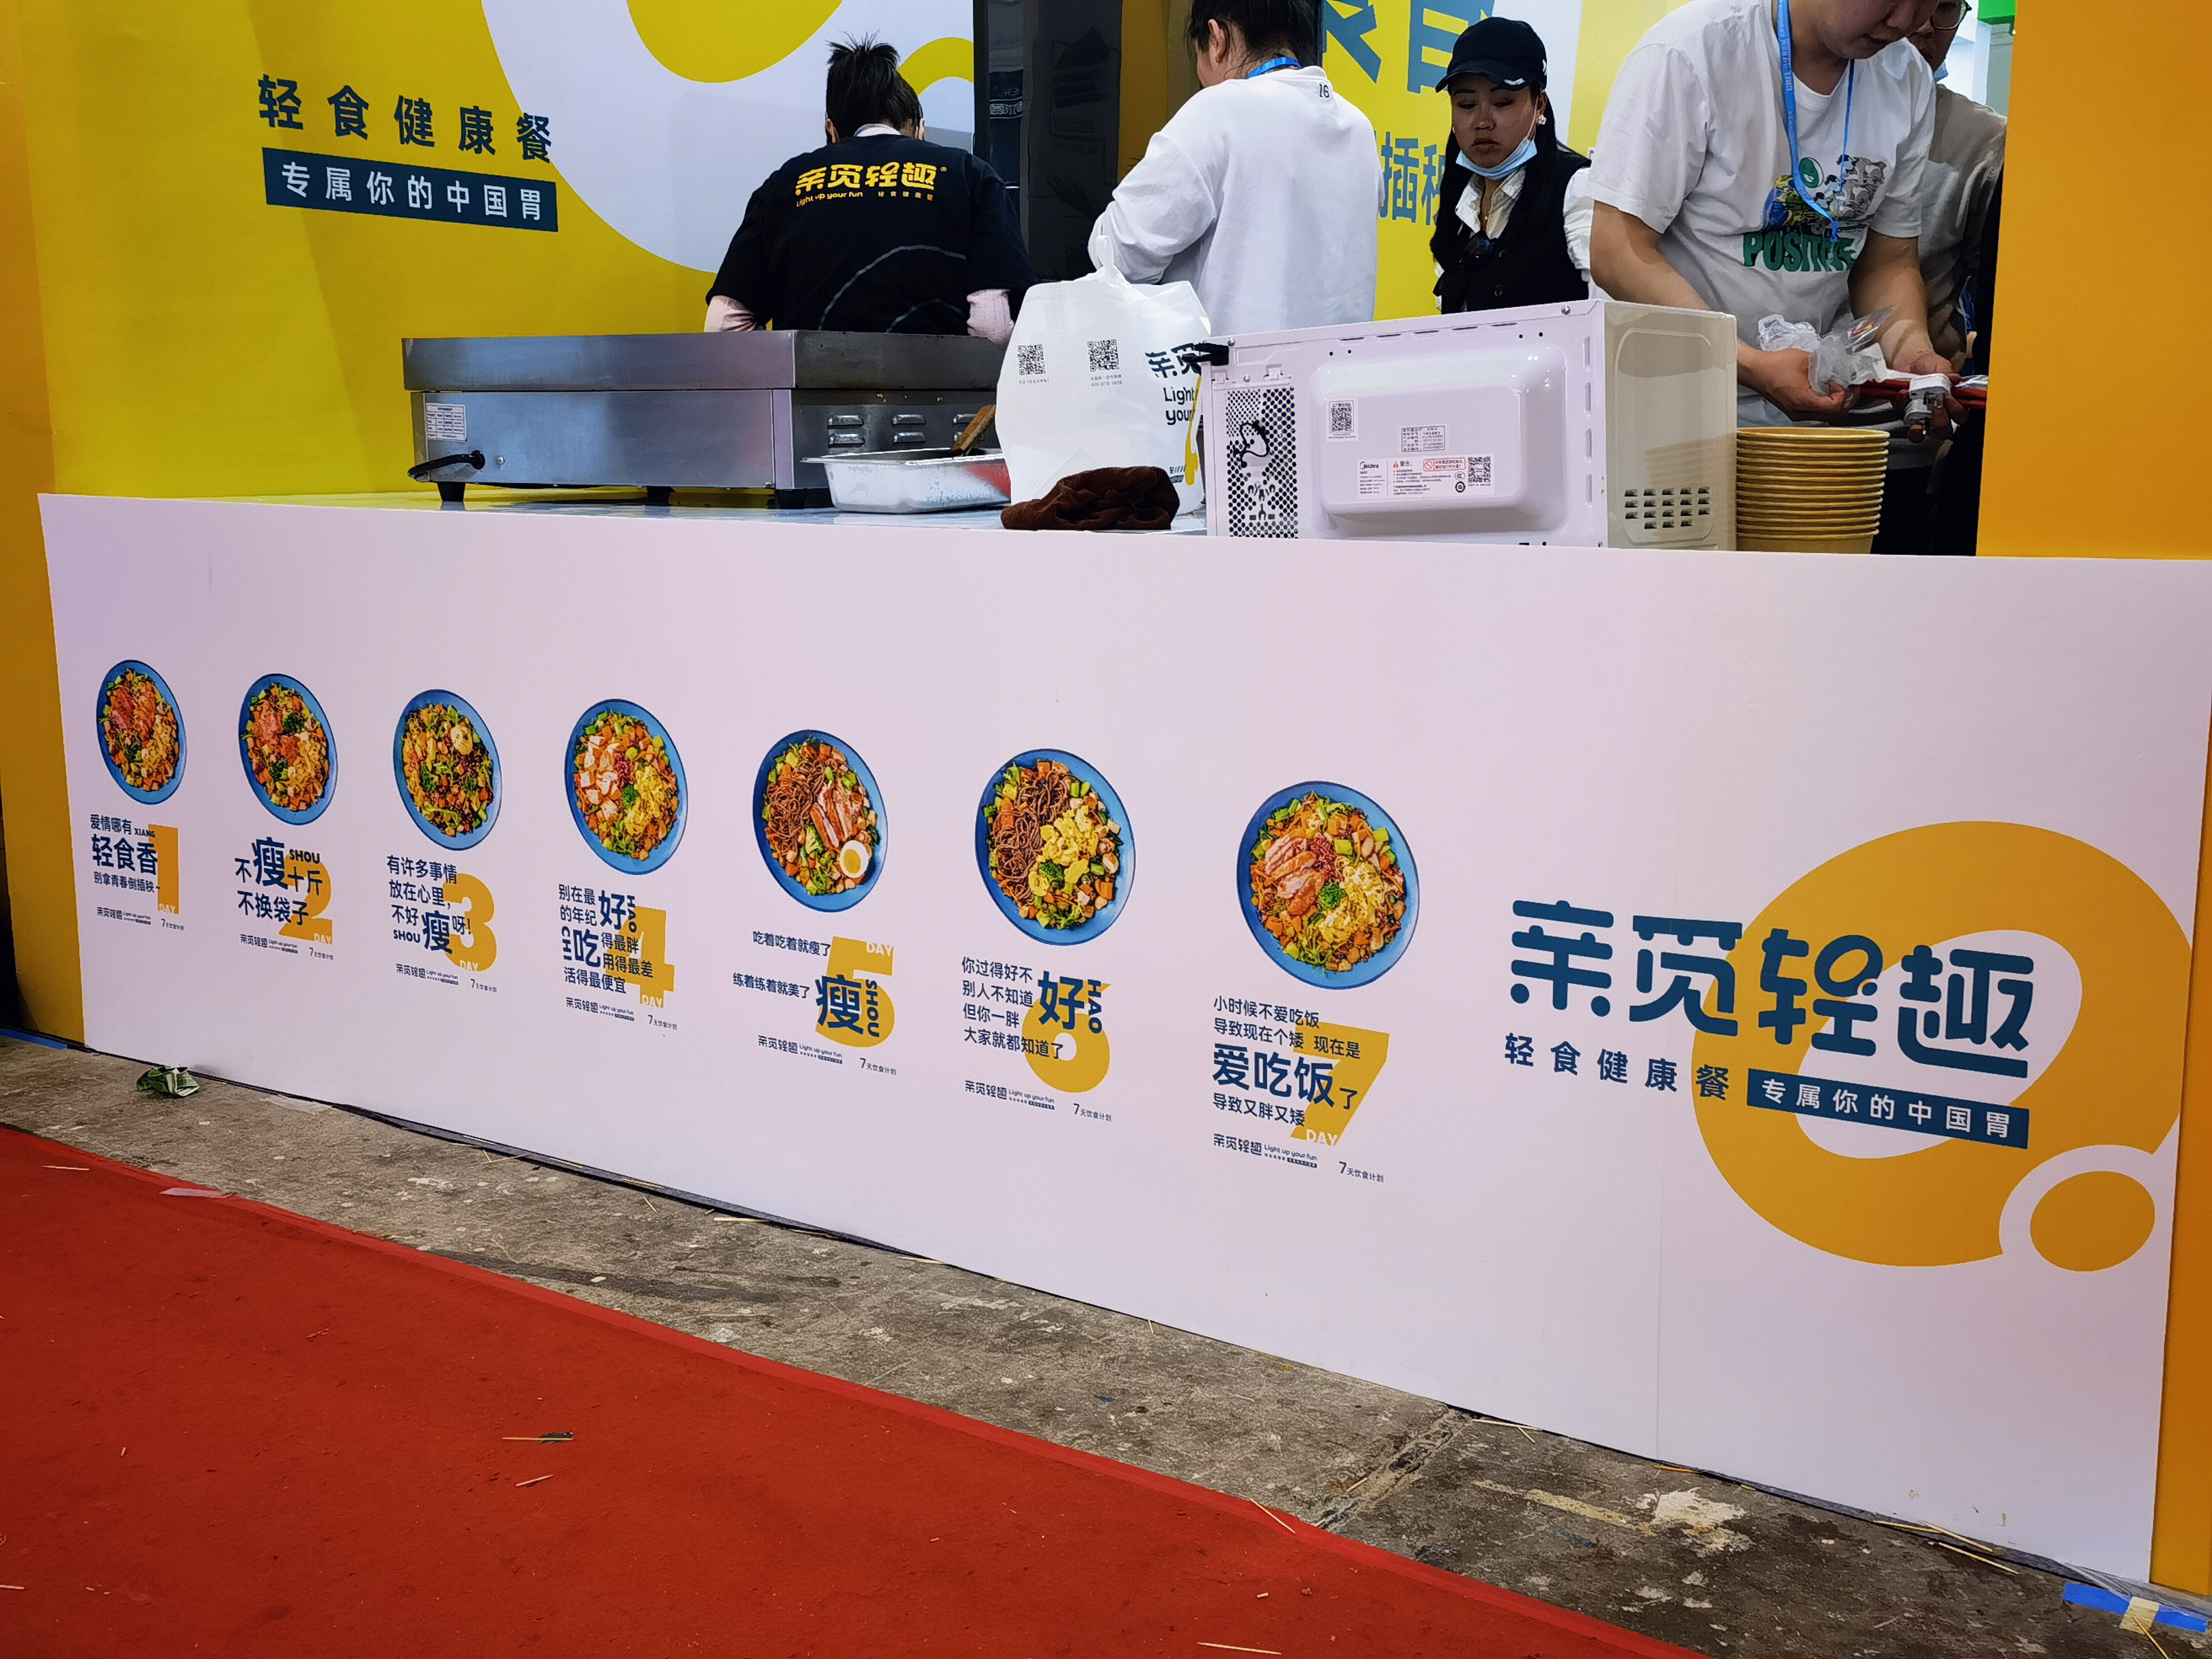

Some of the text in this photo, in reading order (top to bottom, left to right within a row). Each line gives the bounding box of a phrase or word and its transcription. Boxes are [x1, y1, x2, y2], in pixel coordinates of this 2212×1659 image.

[258, 73, 551, 164] 轻食健康餐
[281, 161, 541, 221] 专属你的中国胃
[795, 161, 938, 196] 亲觅轻趣
[1163, 387, 1195, 405] Light
[90, 814, 132, 835] 爱情哪有
[134, 828, 156, 838] XIANG
[91, 834, 158, 875] 轻食香
[234, 837, 323, 895] 不瘦十斤
[289, 848, 321, 864] SHOU
[387, 854, 457, 884] 有许多事情
[159, 903, 176, 913] DAY
[238, 891, 309, 926] 不换袋子
[279, 854, 334, 945] 2
[558, 884, 596, 906] 别在最
[598, 889, 626, 930] 好
[442, 873, 497, 972] 3
[560, 905, 597, 927] 的年纪
[626, 895, 637, 933] HAO
[314, 933, 331, 945] DAY
[393, 929, 420, 943] SHOU
[561, 926, 572, 961] CHI
[601, 932, 639, 954] 得最胖
[753, 931, 831, 956] 吃着吃着就瘦了
[866, 942, 892, 956] DAY
[460, 960, 478, 972] DAY
[603, 953, 653, 979] 用得最差
[605, 906, 675, 1008] 4
[962, 956, 1033, 983] 你过得好不
[564, 966, 626, 994] 活得最便宜
[733, 972, 810, 999] 练着练着就美了
[815, 936, 895, 1048] 5
[962, 980, 1034, 1007] 别人不知道
[1510, 899, 2035, 1079] 亲觅轻趣
[642, 994, 663, 1008] DAY
[815, 974, 864, 1035] 瘦
[866, 979, 880, 1038] SHOU
[1037, 970, 1084, 1030] 好
[1088, 979, 1103, 1034] HAO
[1213, 995, 1320, 1028] 小时候不爱吃饭
[963, 1003, 1020, 1028] 但你一胖
[964, 1027, 1064, 1060] 大家就都知道了
[1213, 1017, 1361, 1059] 导致现在个矮 现在是
[860, 1057, 896, 1075] 7天饮食计划
[1291, 1022, 1390, 1146] 7
[1504, 1031, 2011, 1139] 轻食健康餐 专属你的中国胃
[1073, 1103, 1111, 1122] 7天饮食计划
[1213, 1092, 1305, 1127] 导致又胖又矮
[1264, 1144, 1280, 1153] Light
[1306, 1129, 1337, 1145] DAY
[1339, 1161, 1384, 1183] 7天饮食计划
